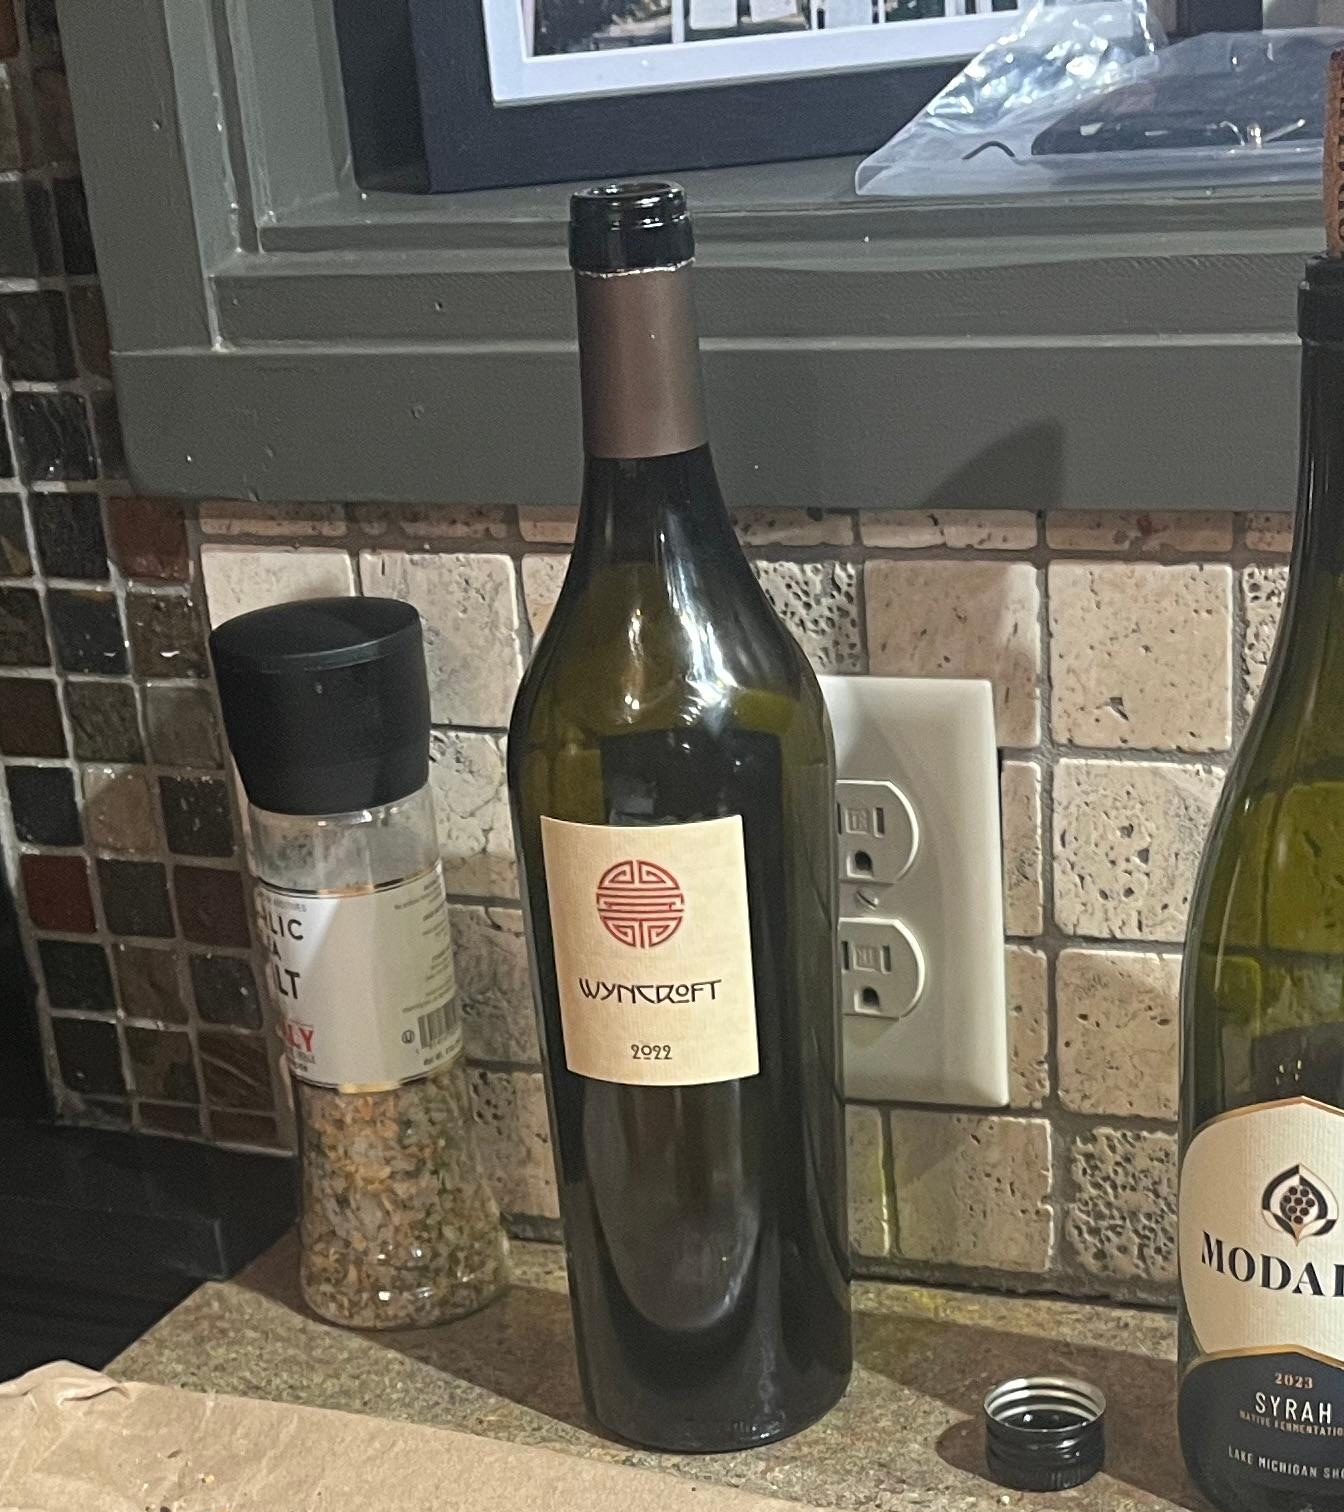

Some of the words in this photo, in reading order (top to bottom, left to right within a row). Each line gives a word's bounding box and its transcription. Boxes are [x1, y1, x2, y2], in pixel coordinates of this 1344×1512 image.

[578, 977, 723, 1004] WYNCROFT
[631, 1043, 673, 1060] 2022
[1274, 1372, 1314, 1389] 2023
[1239, 1410, 1271, 1429] NATIVE
[1255, 1391, 1332, 1425] SYRAH
[1228, 1444, 1253, 1465] LAKE
[1258, 1455, 1318, 1478] MICHIGAN
